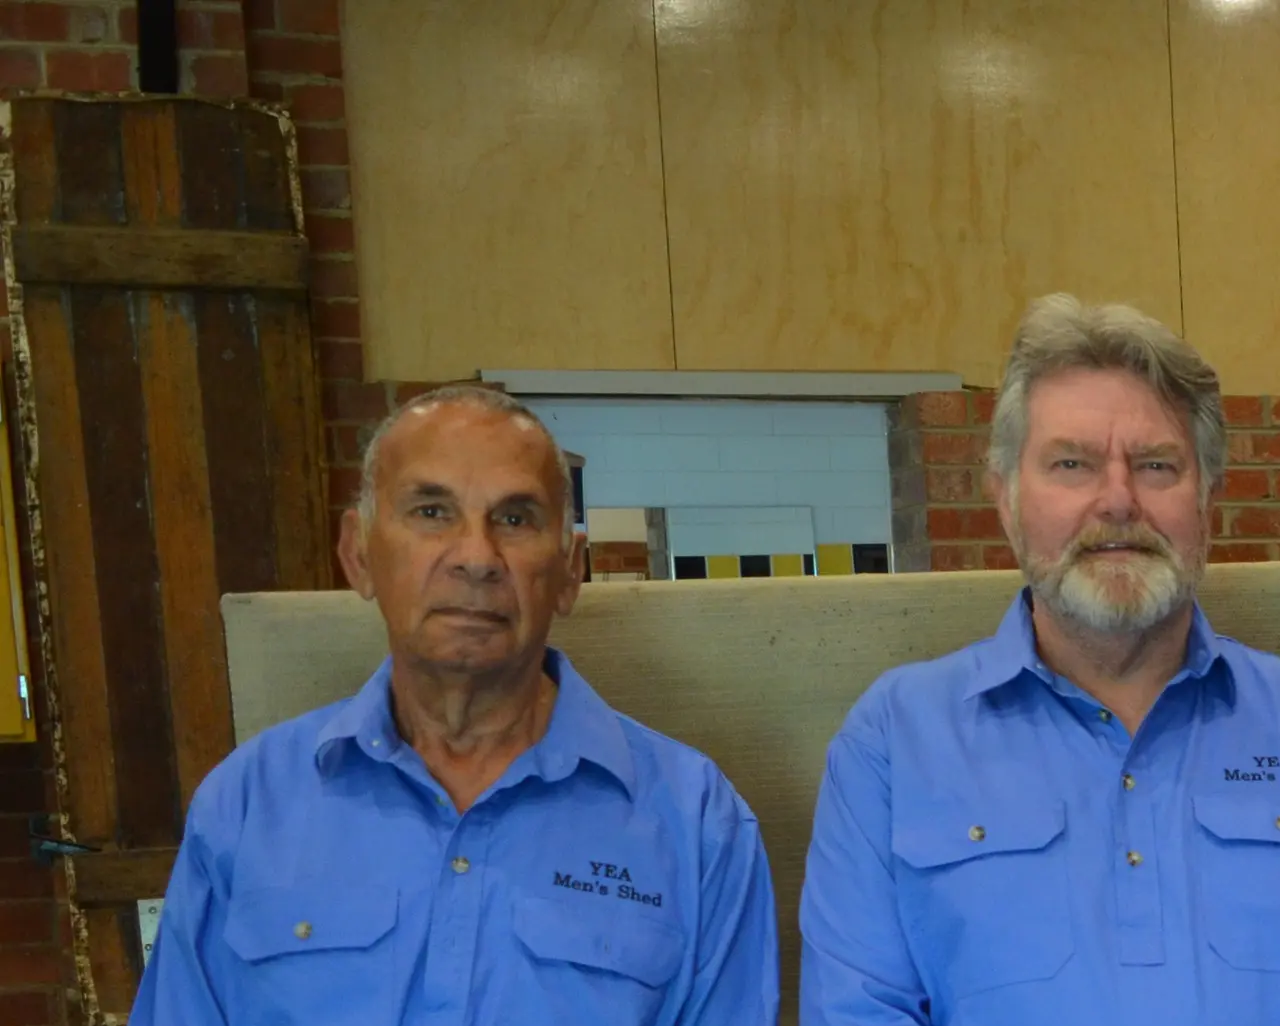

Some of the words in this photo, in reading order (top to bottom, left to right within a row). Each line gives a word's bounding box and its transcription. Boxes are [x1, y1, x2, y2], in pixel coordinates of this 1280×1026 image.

[1224, 768, 1276, 782] Men's
[589, 861, 632, 883] YEA
[553, 871, 609, 896] Men's
[617, 884, 663, 908] Shed
